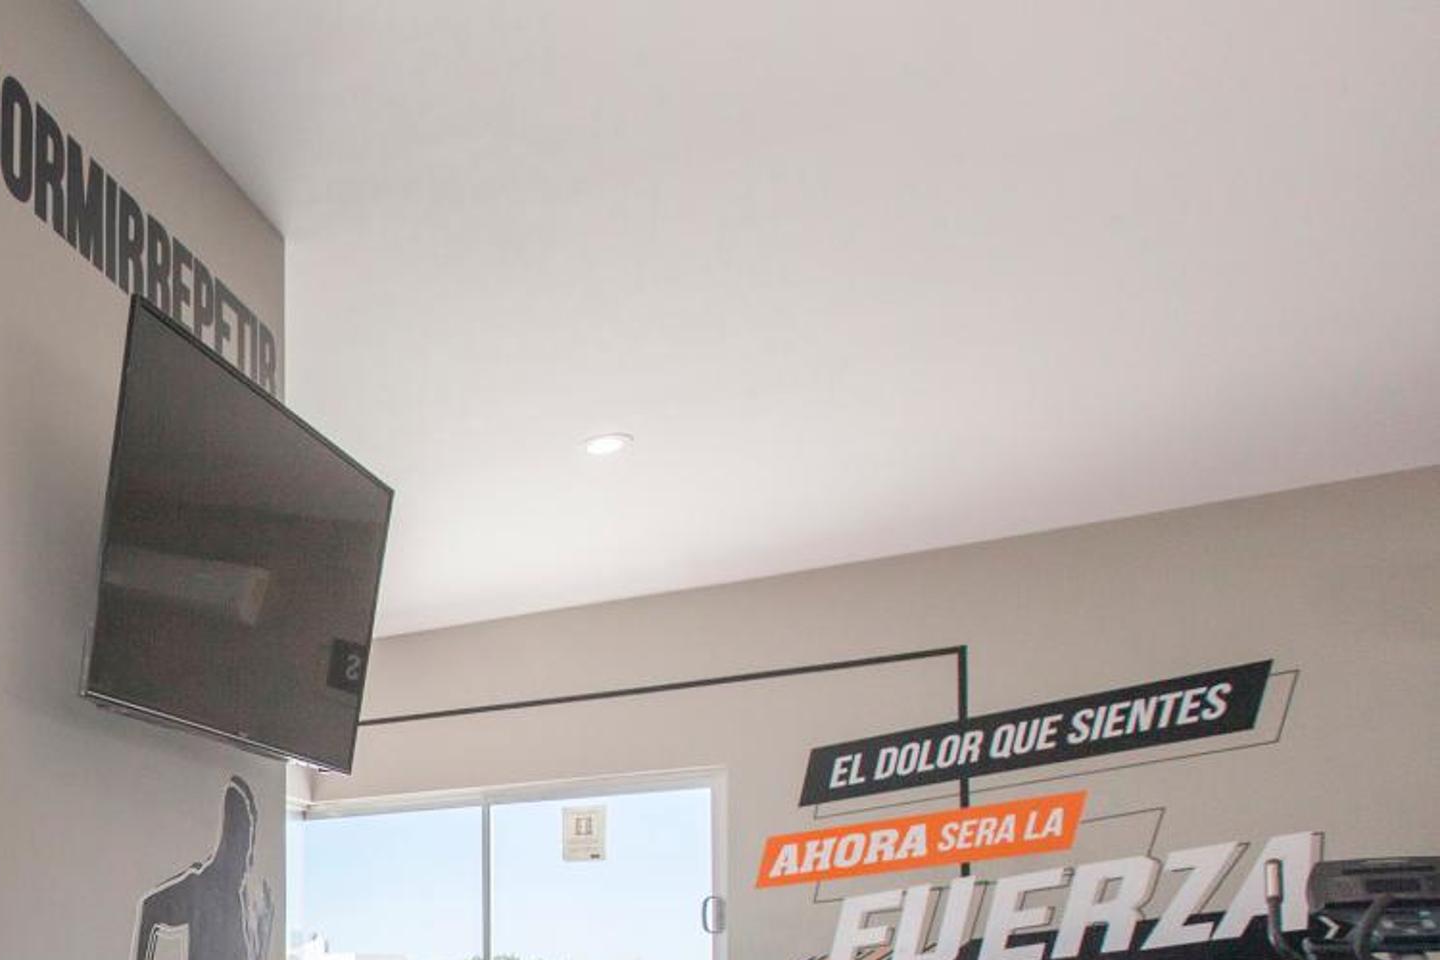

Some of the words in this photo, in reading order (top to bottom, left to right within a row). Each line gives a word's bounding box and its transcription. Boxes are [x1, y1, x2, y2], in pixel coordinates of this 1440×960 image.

[147, 214, 277, 397] REPETIR
[828, 754, 869, 790] EL
[873, 725, 982, 783] DOLOR
[989, 708, 1059, 761] QUE
[1068, 682, 1233, 747] SIENTES
[768, 822, 927, 879] AHORA
[936, 812, 1016, 852] SERA
[1023, 806, 1066, 841] LA
